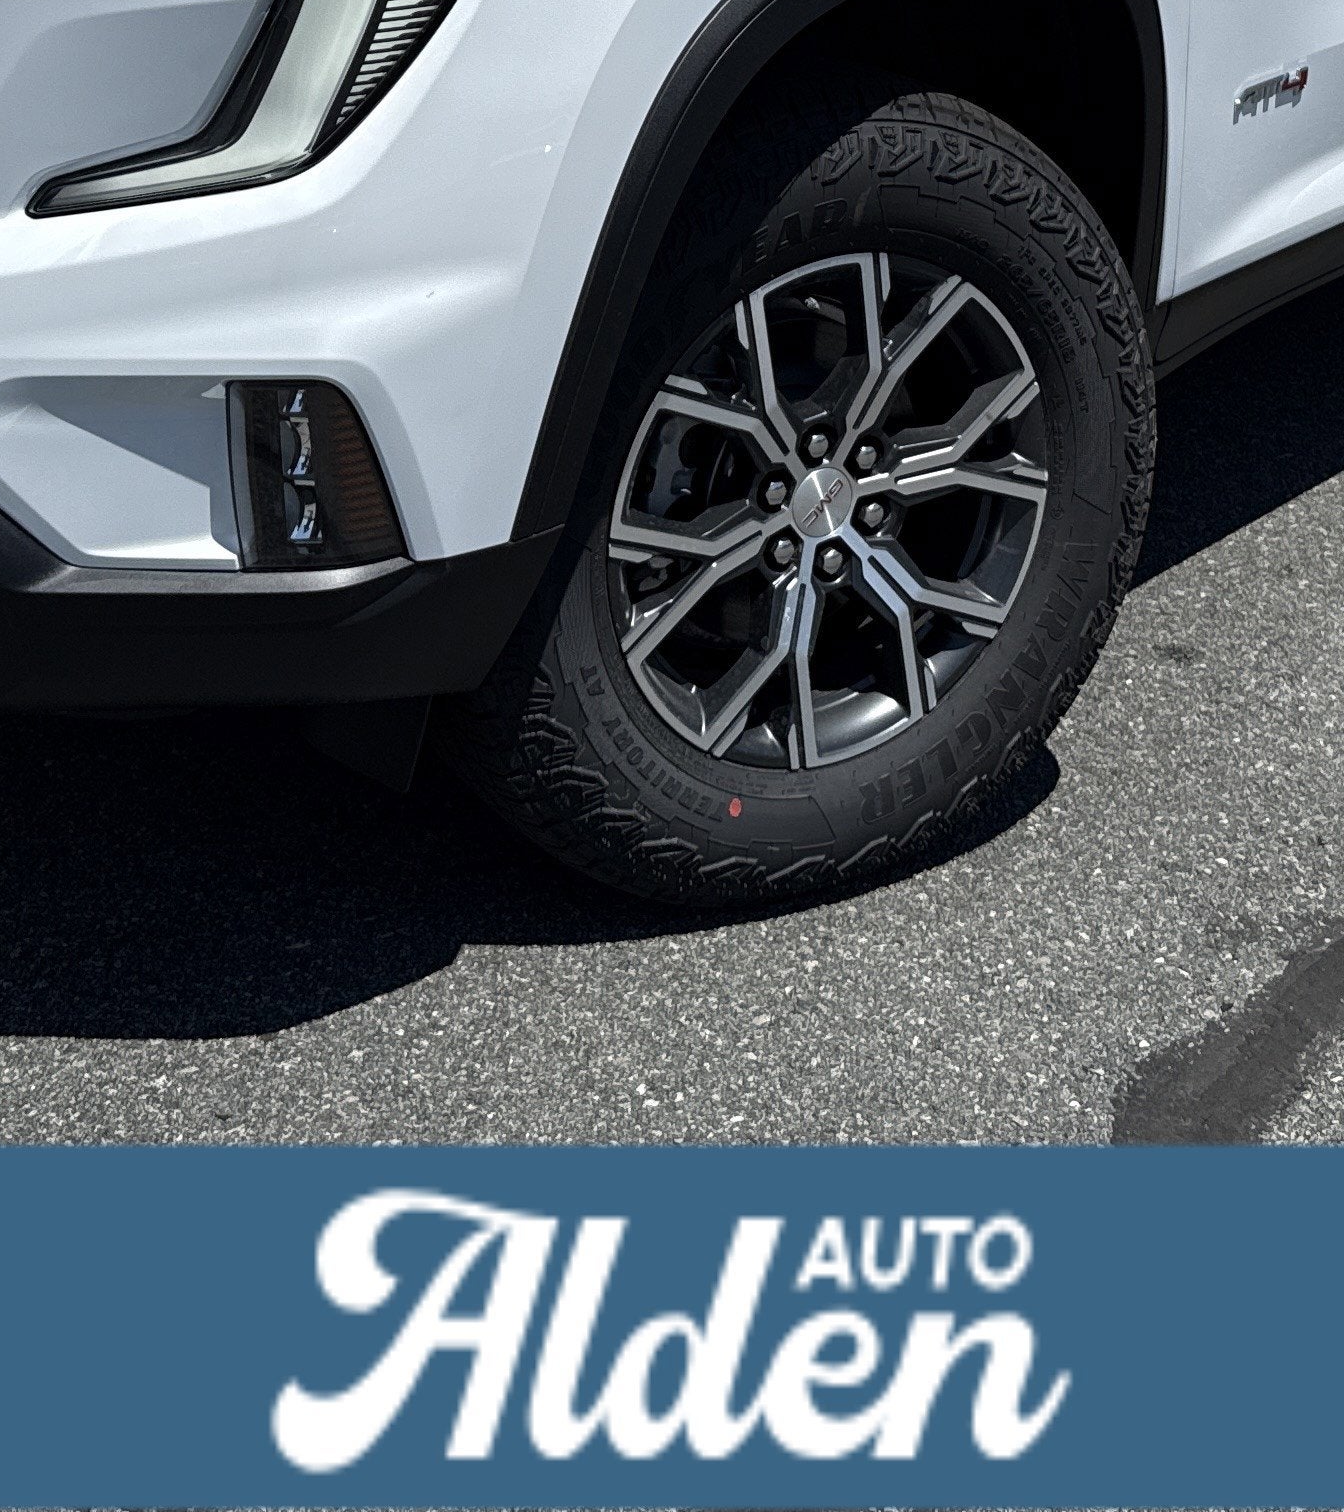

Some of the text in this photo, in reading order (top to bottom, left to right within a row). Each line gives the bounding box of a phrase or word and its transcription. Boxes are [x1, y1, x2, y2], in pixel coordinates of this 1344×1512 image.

[802, 478, 844, 529] GMC
[578, 658, 730, 824] TERRITORY AT
[857, 541, 1098, 829] WRANGLER
